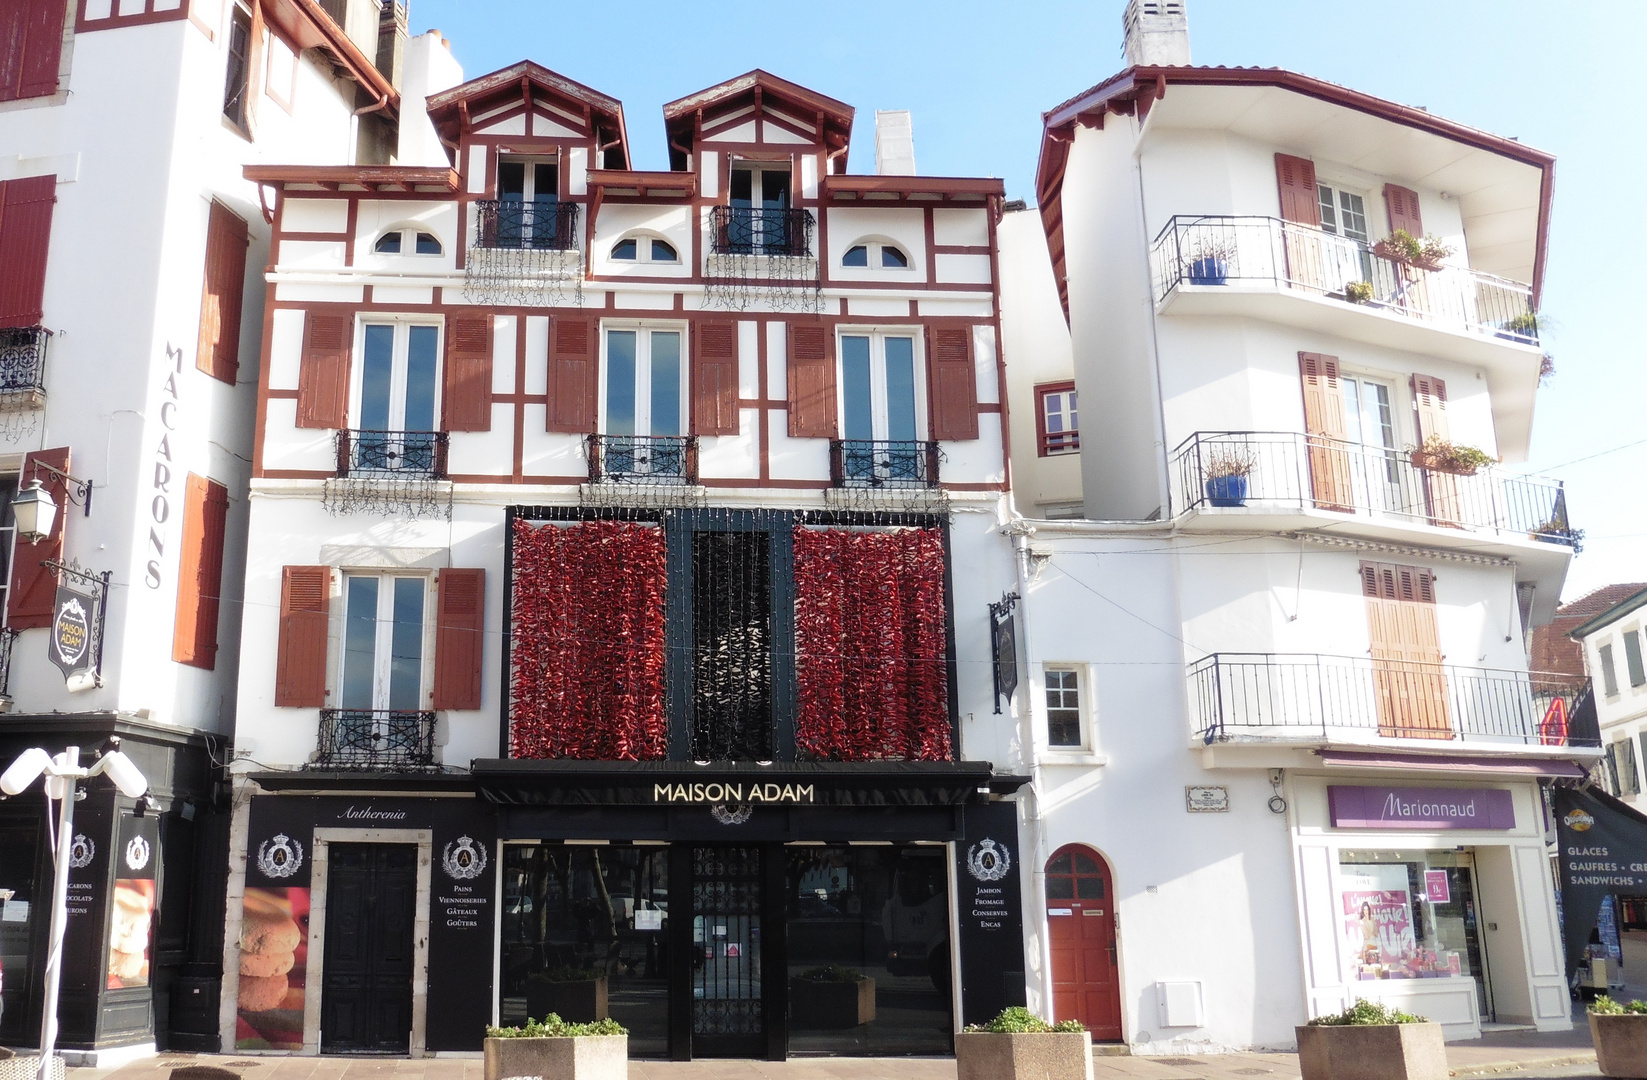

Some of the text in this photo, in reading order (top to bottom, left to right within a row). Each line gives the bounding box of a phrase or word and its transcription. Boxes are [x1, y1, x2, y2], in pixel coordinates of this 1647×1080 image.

[145, 340, 183, 590] MACARONS
[58, 621, 86, 638] MAISON
[60, 633, 82, 648] ADAM
[654, 783, 814, 803] MAISON ADAM
[337, 805, 407, 820] Antherenia
[1381, 792, 1476, 822] Marionnaud
[275, 849, 285, 863] A
[1567, 846, 1609, 856] GLACES
[459, 851, 469, 865] A
[984, 853, 993, 867] A
[1569, 861, 1618, 872] GAUFRES
[1570, 875, 1634, 886] SANDWICHS
[453, 884, 473, 893] PAINS
[976, 887, 1002, 895] JAMBON
[439, 896, 487, 904] VIENNOISERIES
[974, 898, 1005, 906] FROMAGE
[446, 907, 478, 916] GÂTEAUX
[972, 909, 1008, 917] CONSERVES
[446, 919, 478, 928] GOÛTERS
[980, 920, 1001, 929] ENCAS
